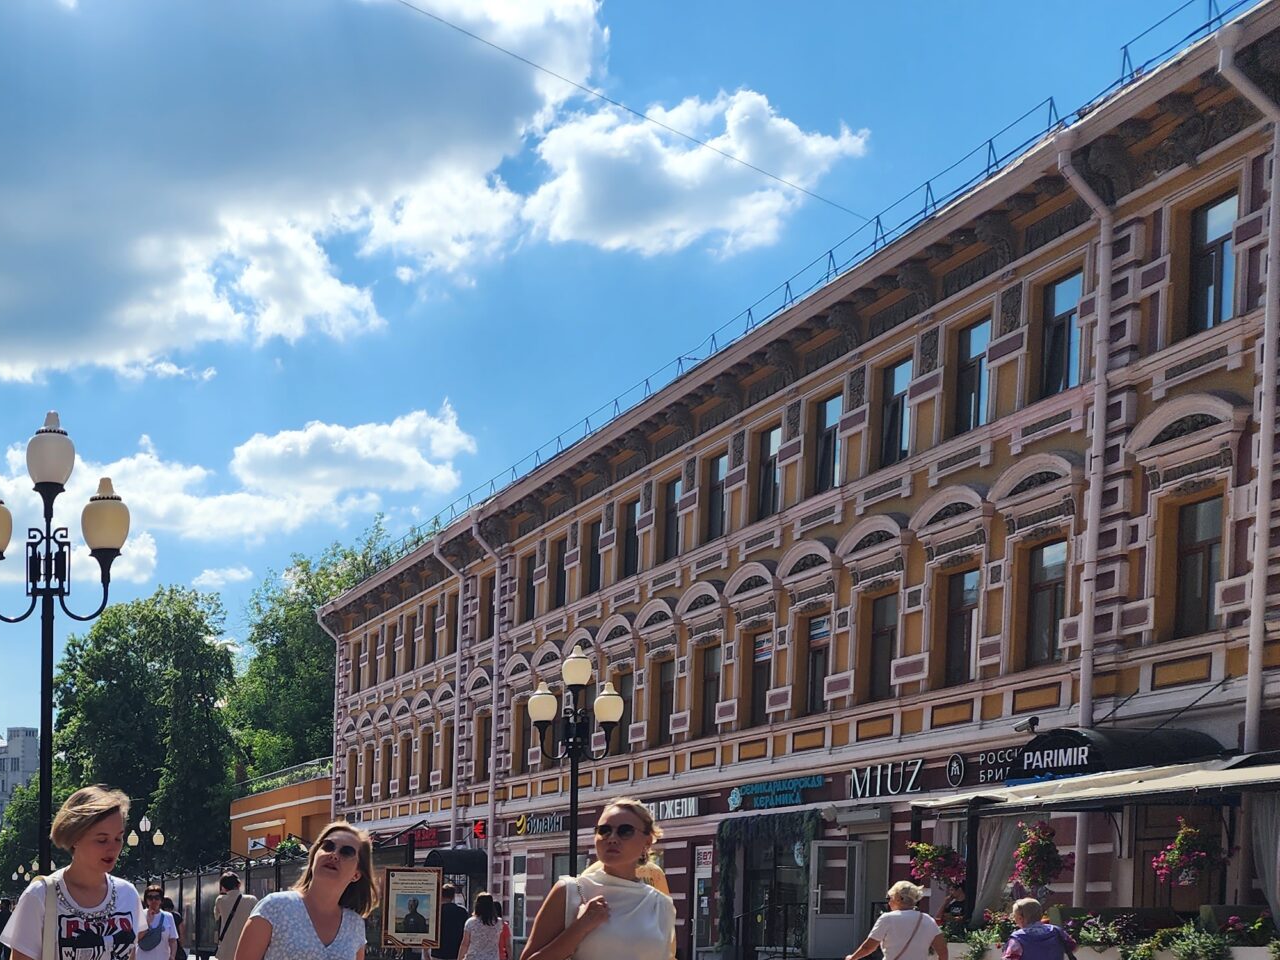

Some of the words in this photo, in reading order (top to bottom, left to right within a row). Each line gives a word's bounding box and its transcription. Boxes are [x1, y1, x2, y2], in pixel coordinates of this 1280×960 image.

[1023, 746, 1089, 770] PARIMIR
[850, 758, 923, 799] MIUZ
[659, 797, 696, 820] ГЖЕЛИ
